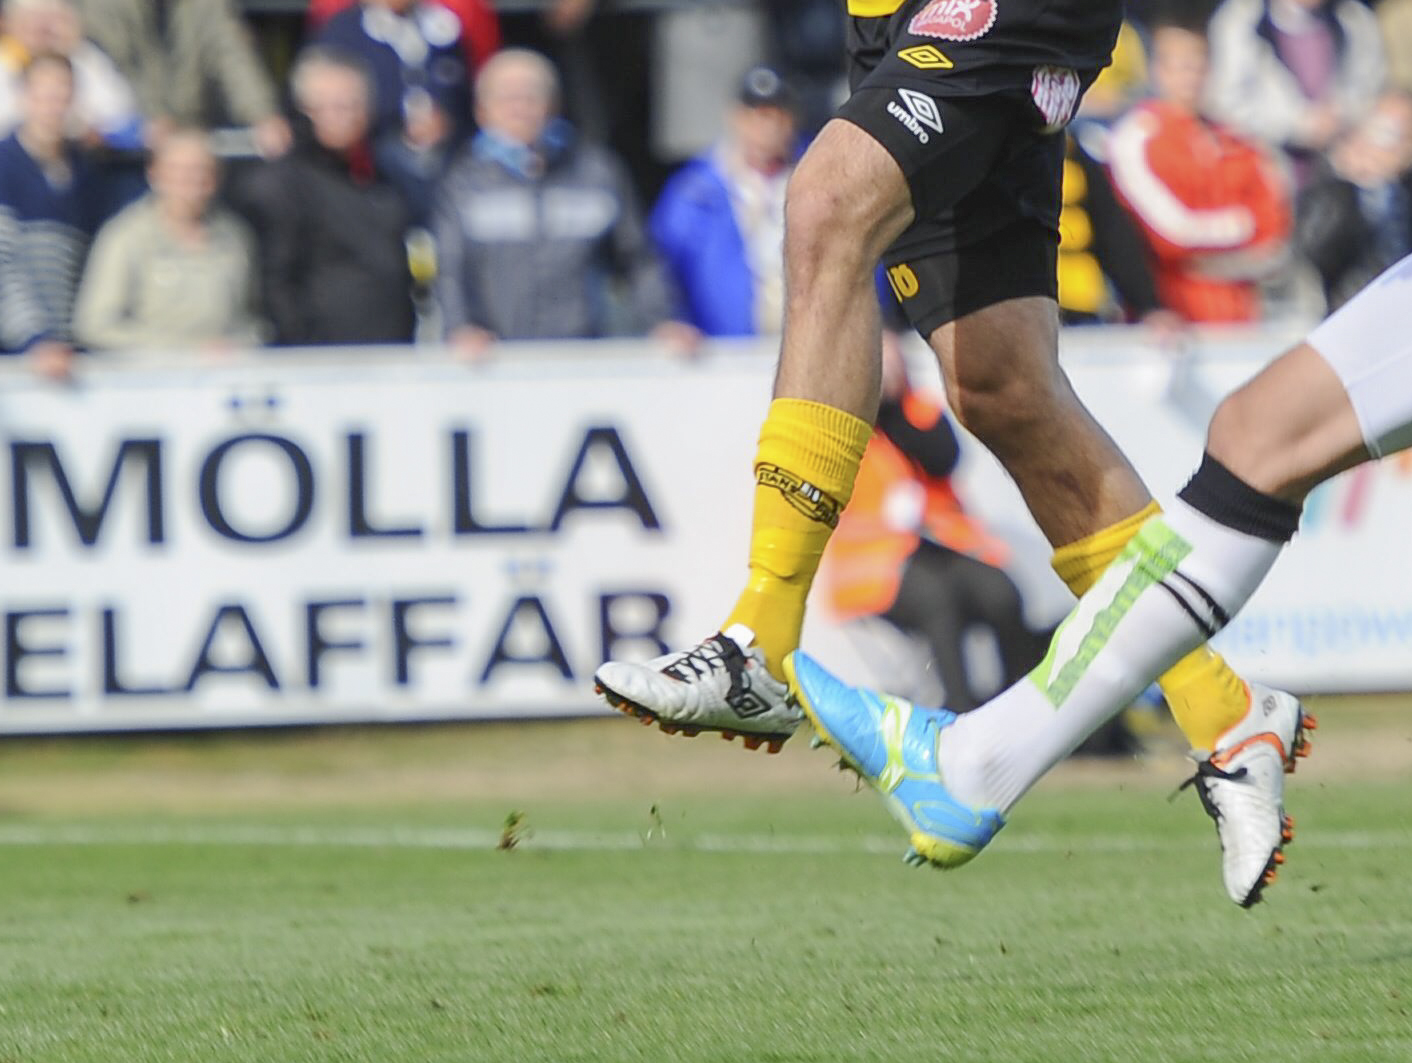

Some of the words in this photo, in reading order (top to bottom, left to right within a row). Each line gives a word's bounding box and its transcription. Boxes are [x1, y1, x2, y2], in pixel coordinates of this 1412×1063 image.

[886, 100, 930, 145] umbro
[9, 394, 665, 549] MÖLLA
[5, 560, 673, 699] ELAFFÄR
